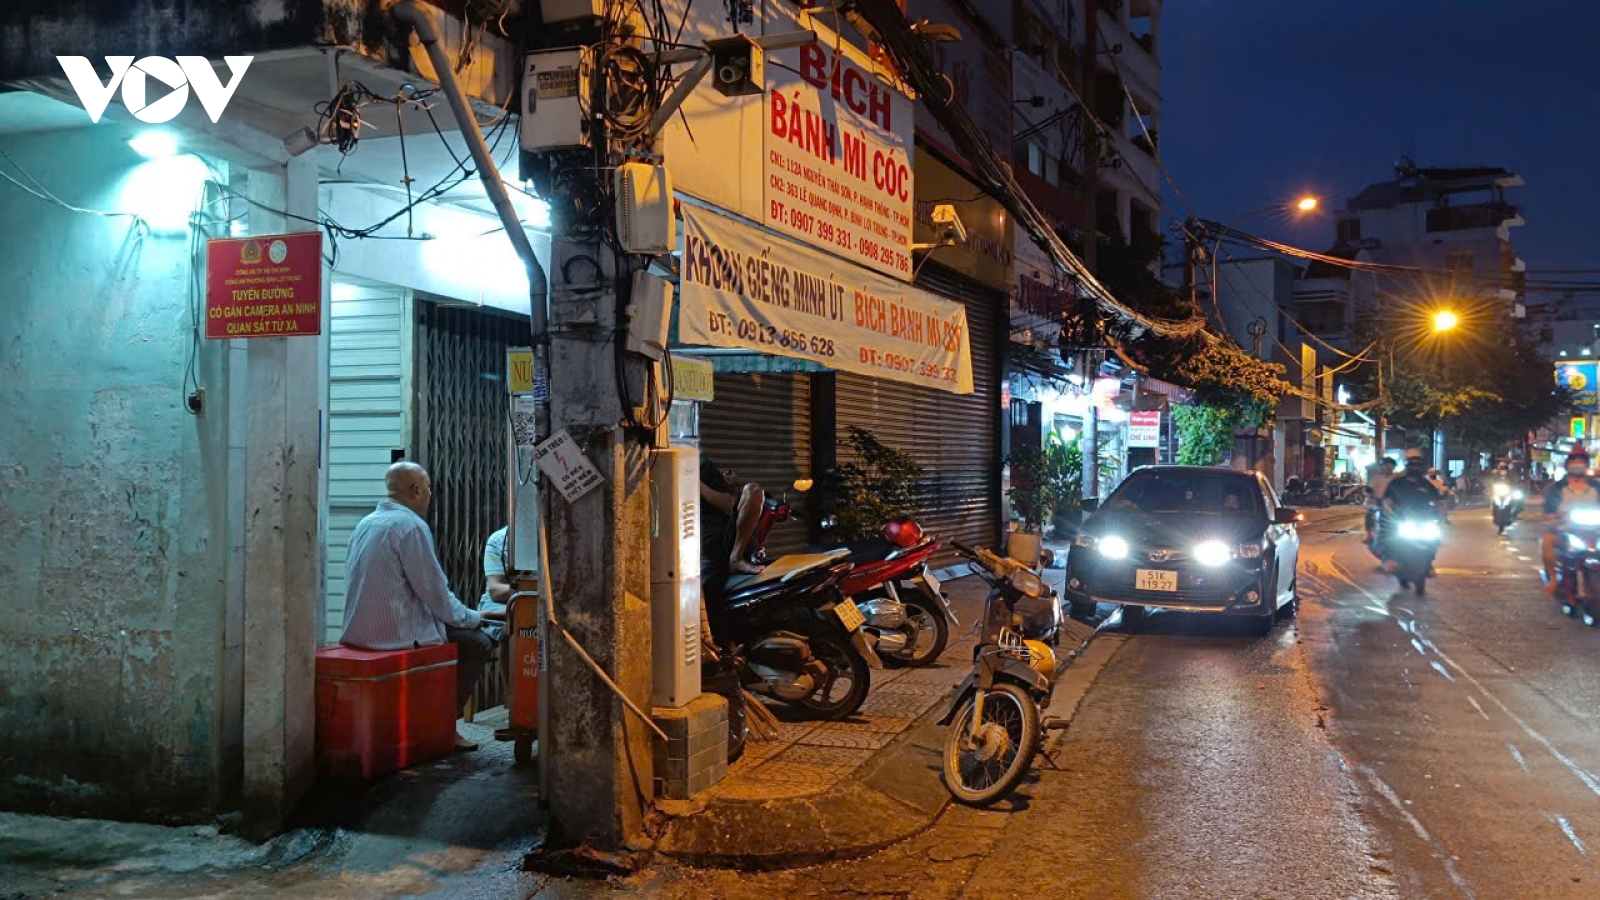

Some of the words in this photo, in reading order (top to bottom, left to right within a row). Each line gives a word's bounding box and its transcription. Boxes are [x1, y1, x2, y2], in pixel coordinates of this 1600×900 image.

[801, 44, 890, 133] BÍCH
[770, 150, 785, 169] CN1:
[771, 89, 835, 165] BÁNH
[844, 129, 867, 182] MÌ
[873, 148, 908, 203] CÓC
[770, 174, 785, 193] CN2:
[787, 181, 798, 198] 363
[771, 199, 788, 224] ĐT:
[790, 208, 814, 235] 0907
[817, 219, 833, 243] 399
[836, 228, 851, 250] 331
[860, 236, 878, 261] 0908
[880, 246, 894, 267] 295
[686, 234, 744, 296] KHOAN
[746, 246, 790, 308] GIẾNG
[793, 270, 826, 317] MINH
[829, 272, 844, 321] ÚT
[227, 322, 251, 334] QUAN
[253, 317, 271, 332] SÁT
[286, 320, 298, 331] XA
[244, 304, 280, 316] CAMERA
[282, 304, 294, 314] AN
[295, 303, 316, 314] NINH
[855, 285, 886, 334] BÍCH
[890, 296, 922, 344] BÁNH
[926, 310, 940, 348] MÌ
[709, 311, 732, 335] ĐT:
[738, 319, 776, 345] 0913
[811, 336, 835, 357] 628
[884, 353, 916, 373] 0907
[1148, 570, 1165, 580] 51K
